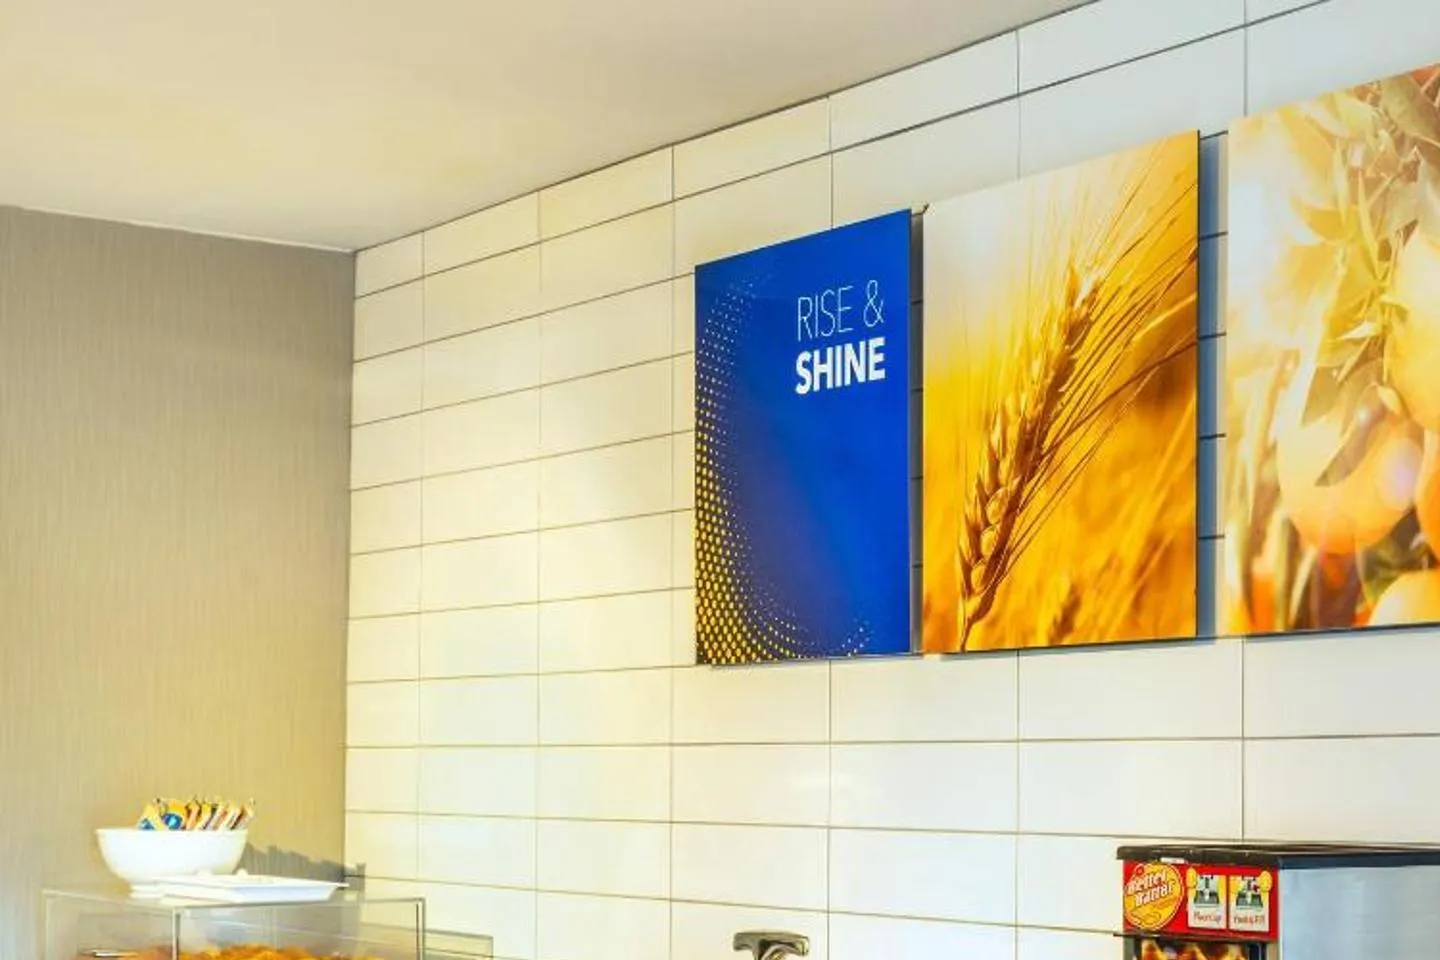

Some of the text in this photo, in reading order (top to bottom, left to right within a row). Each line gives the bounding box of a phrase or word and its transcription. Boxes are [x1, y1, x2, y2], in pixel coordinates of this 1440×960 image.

[798, 279, 884, 341] RISE &
[796, 337, 886, 395] SHINE
